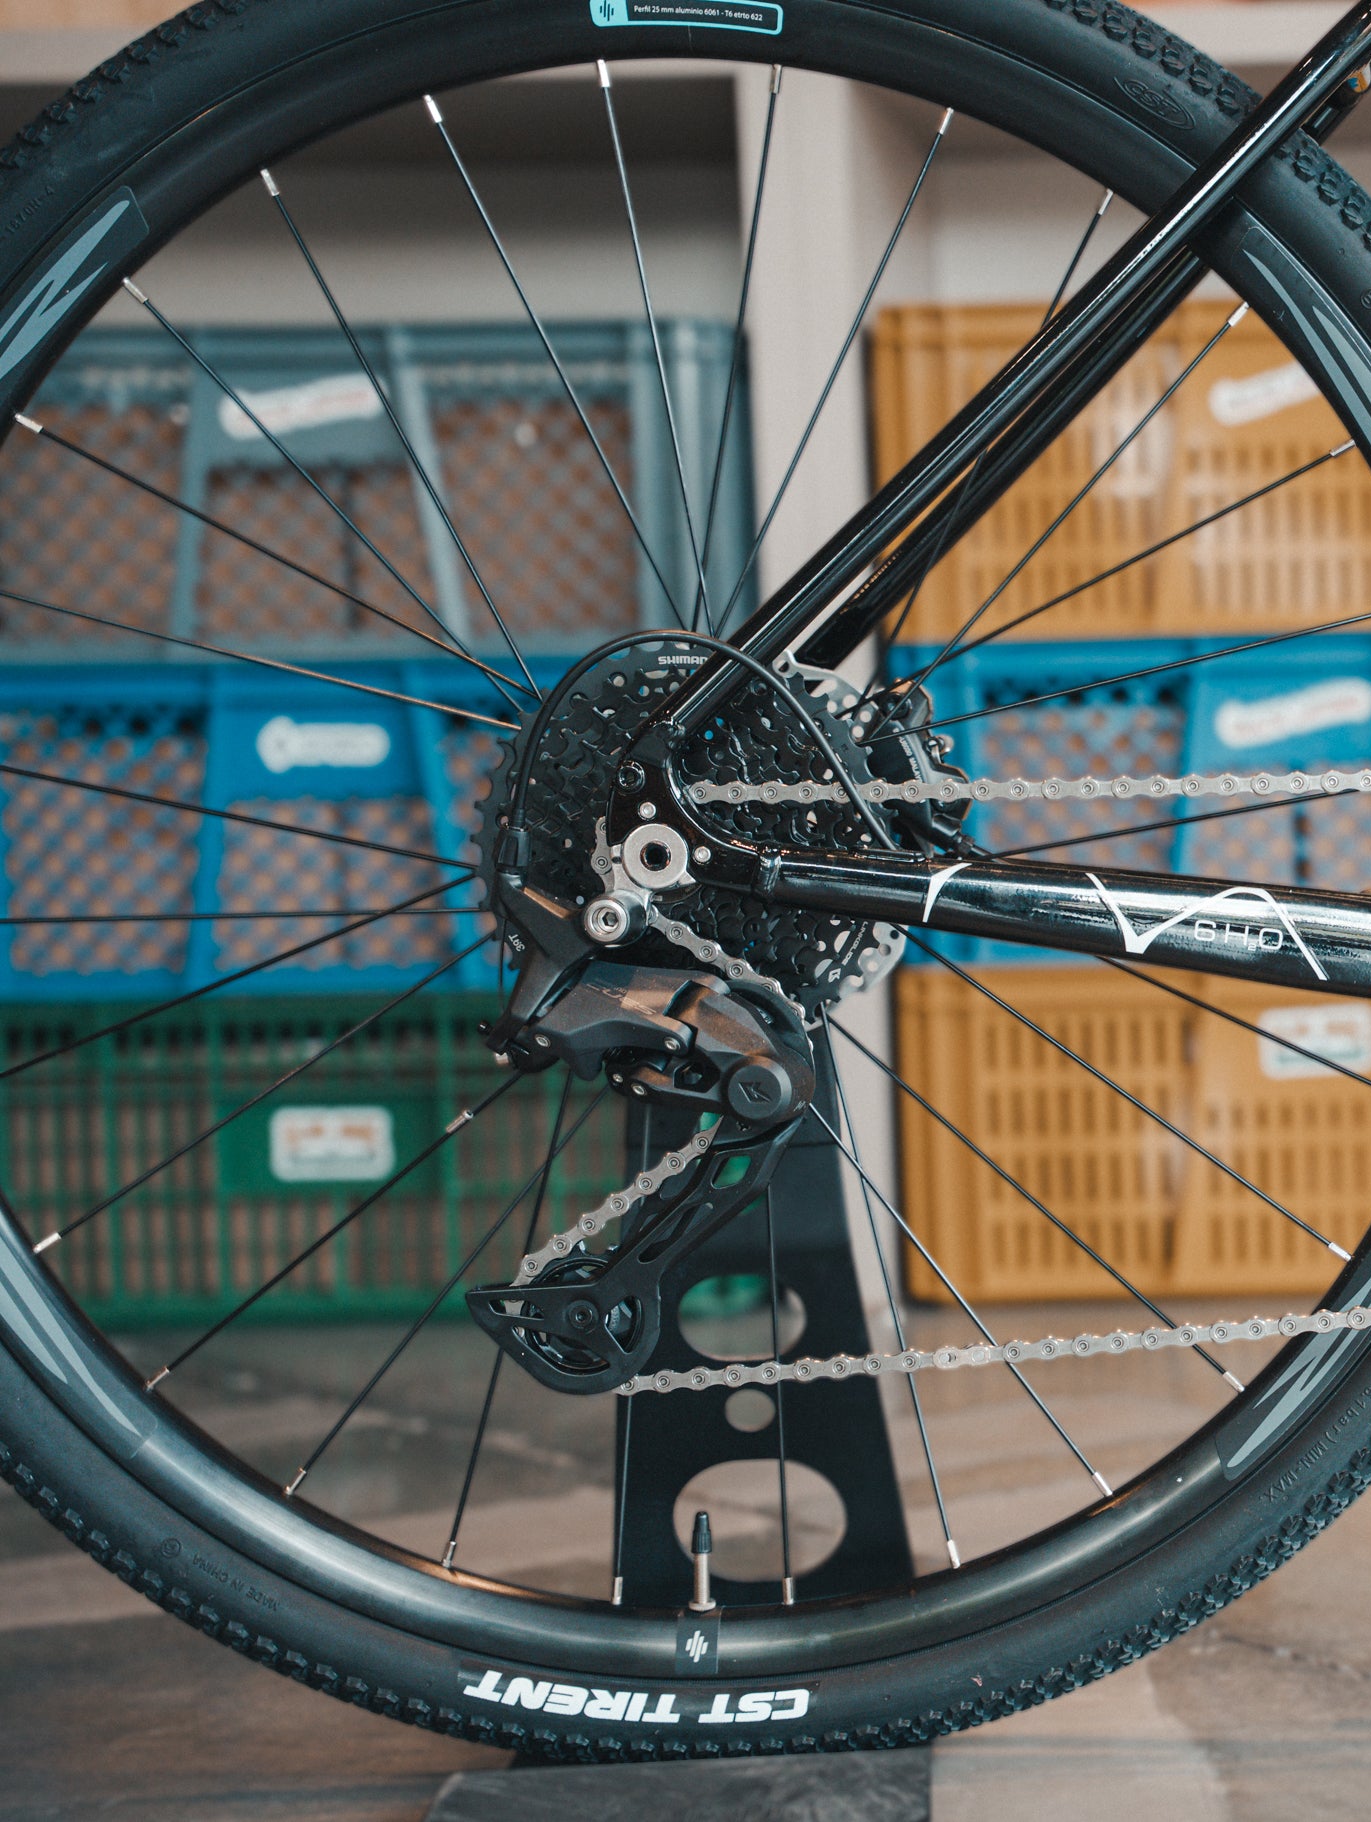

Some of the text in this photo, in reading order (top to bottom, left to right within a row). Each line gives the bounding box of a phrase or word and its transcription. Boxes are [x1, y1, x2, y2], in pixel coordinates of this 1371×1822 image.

[634, 5, 651, 13] Perfil
[675, 7, 704, 15] aluminio
[751, 13, 763, 21] 622
[657, 655, 709, 665] SHIMAN
[462, 1669, 811, 1724] CST TIRENT
